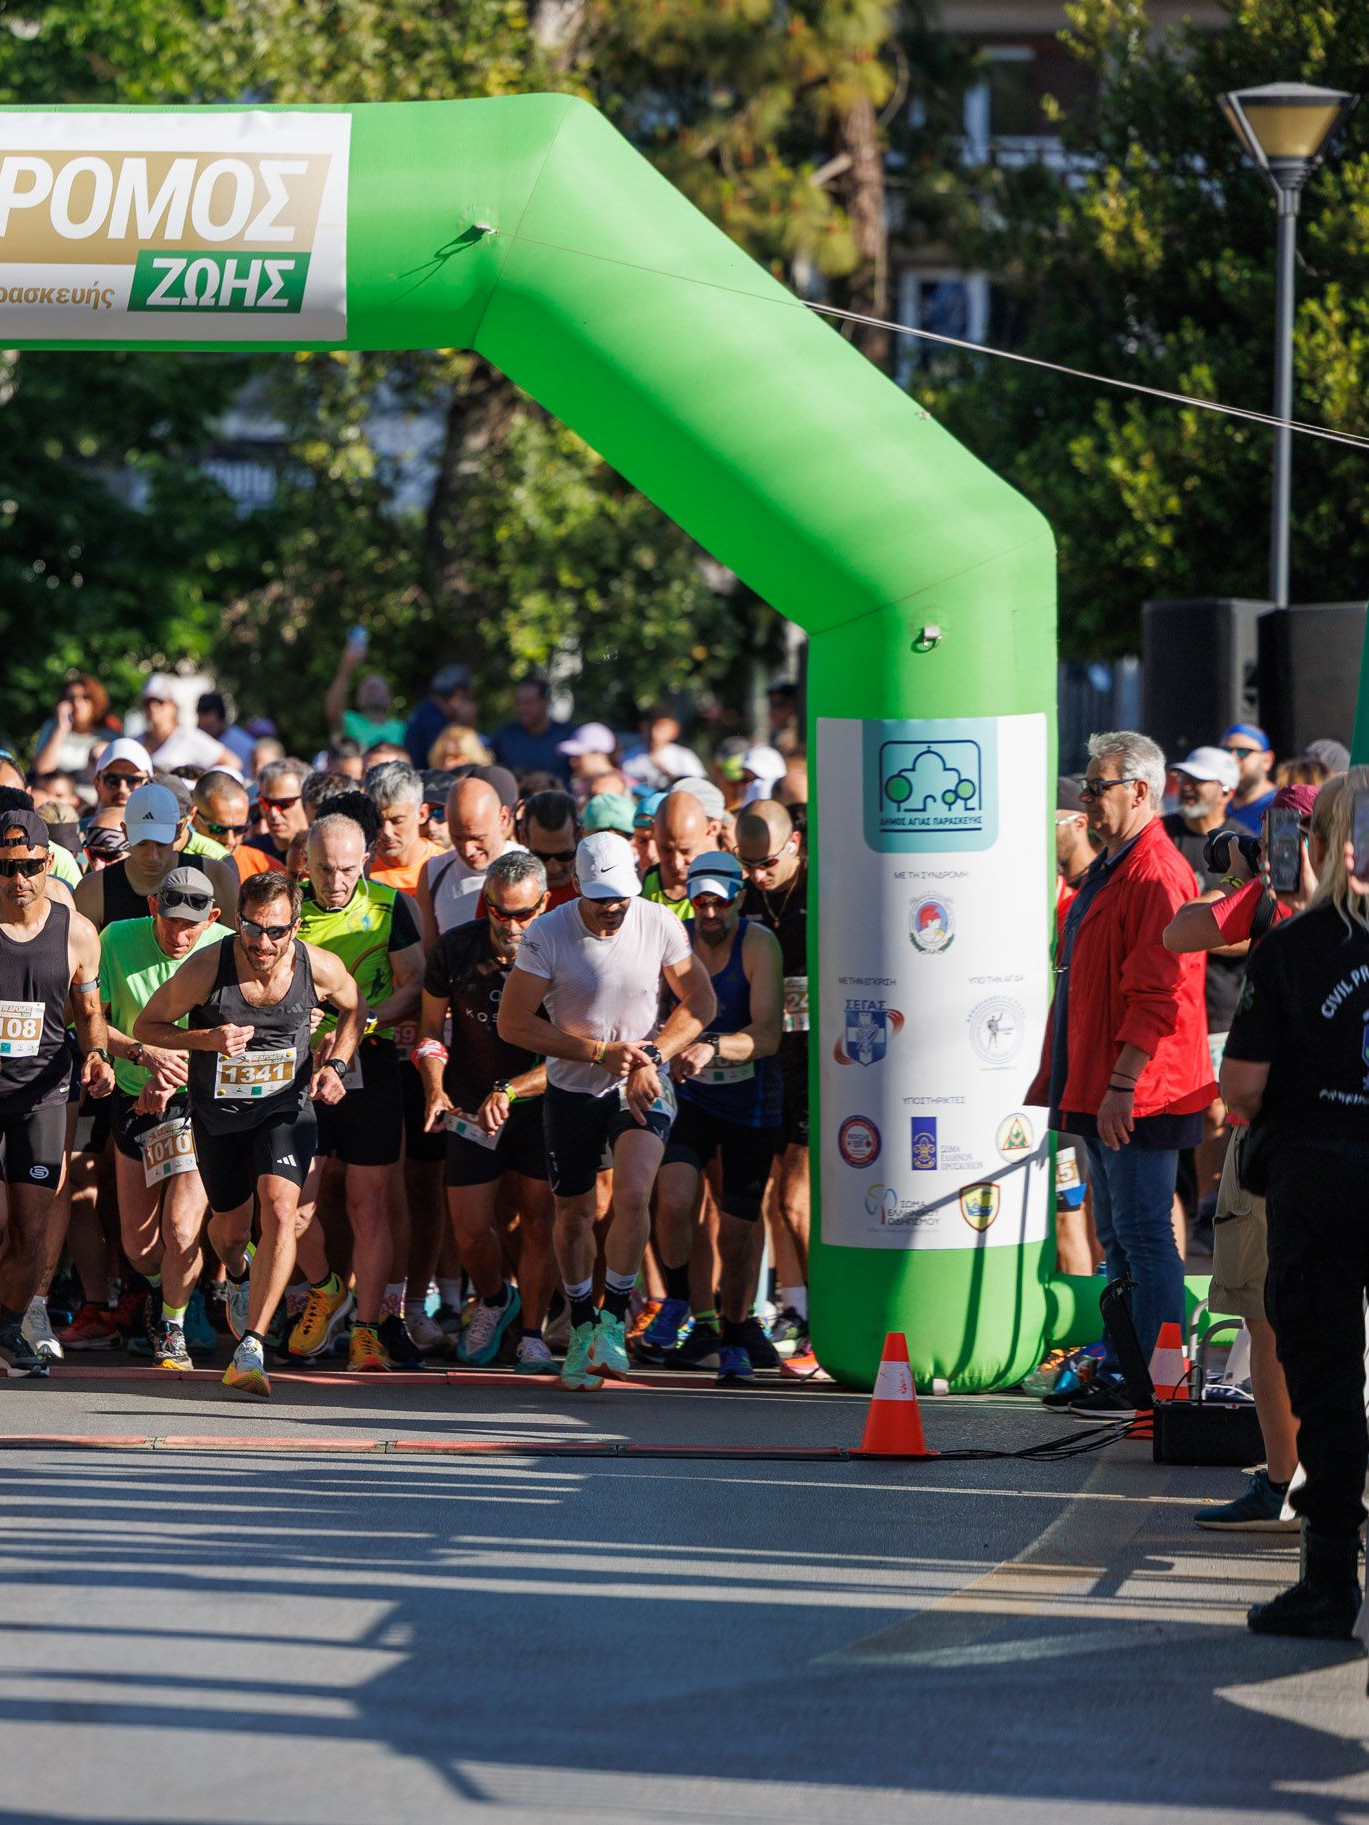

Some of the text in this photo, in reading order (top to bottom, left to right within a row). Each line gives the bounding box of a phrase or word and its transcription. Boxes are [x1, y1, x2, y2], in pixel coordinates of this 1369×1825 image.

[146, 257, 295, 307] ΖΩΗΣ
[933, 816, 982, 826] ΠΑΡΑΣΚΕΥΗΣ
[845, 999, 888, 1010] ΣΕΓΑΣ
[1321, 979, 1353, 1019] CIVIL
[225, 1063, 285, 1083] 1341
[146, 1134, 191, 1165] 1010
